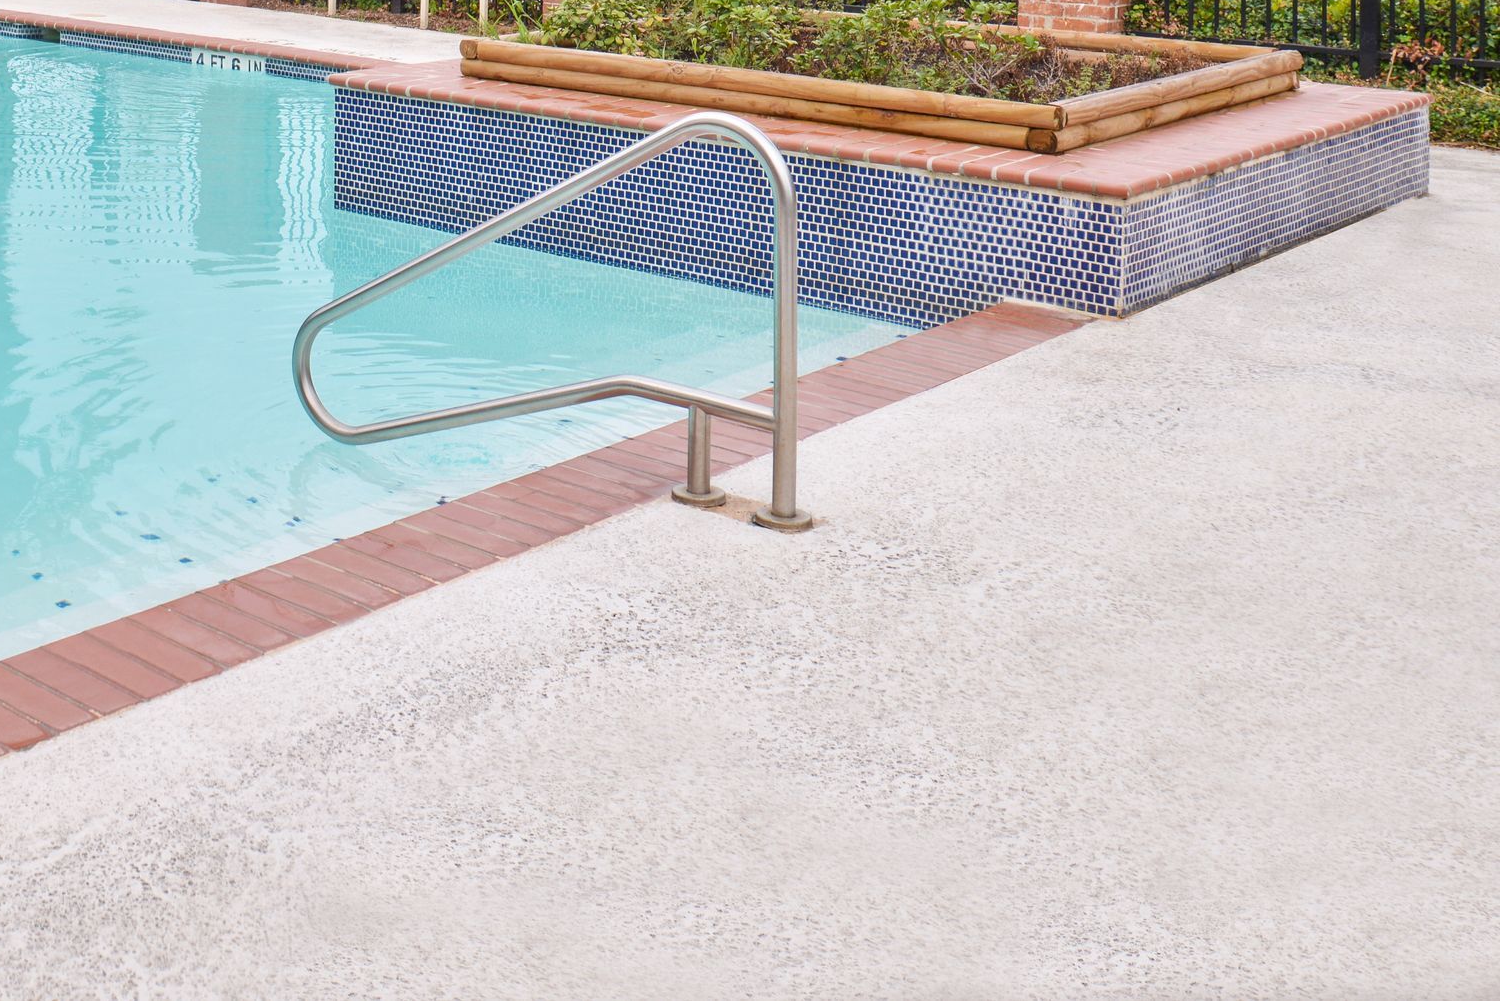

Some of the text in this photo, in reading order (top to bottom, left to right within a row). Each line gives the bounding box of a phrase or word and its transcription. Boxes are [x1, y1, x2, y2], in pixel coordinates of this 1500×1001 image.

[196, 52, 262, 72] 4 FT 6 IN
